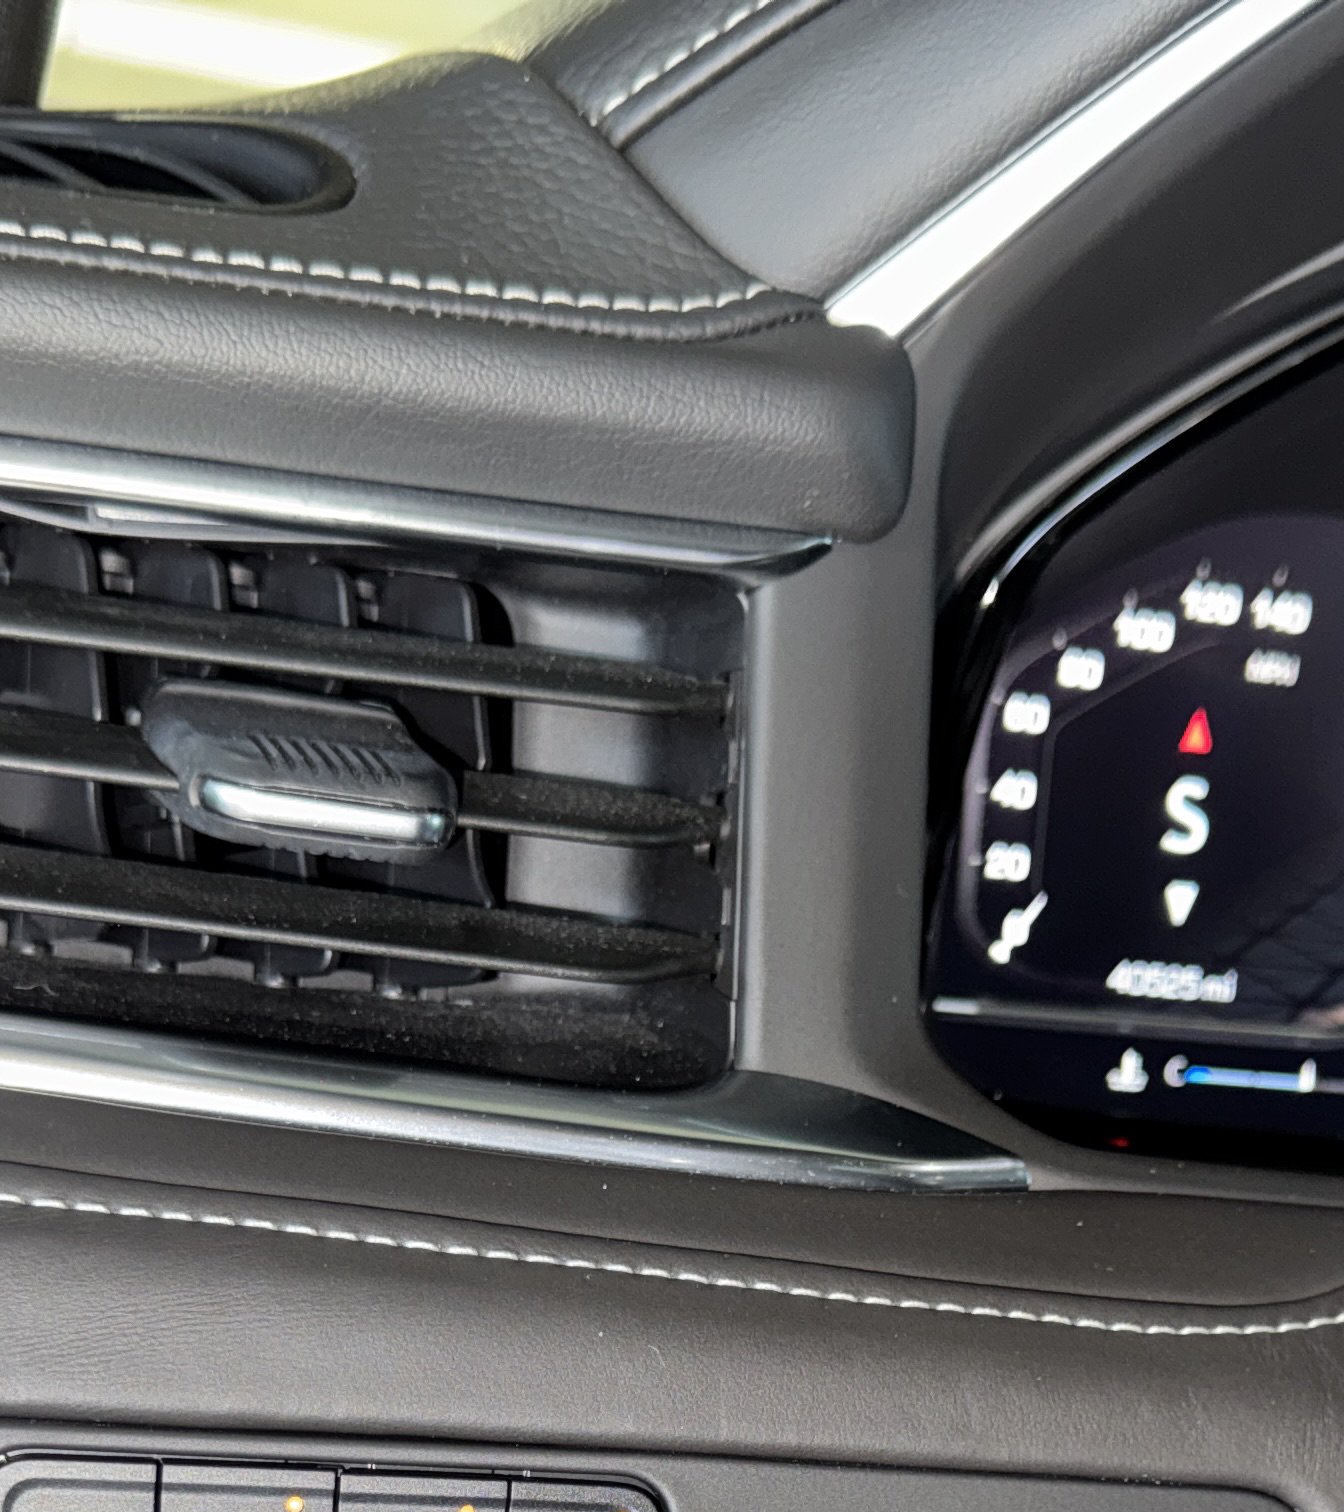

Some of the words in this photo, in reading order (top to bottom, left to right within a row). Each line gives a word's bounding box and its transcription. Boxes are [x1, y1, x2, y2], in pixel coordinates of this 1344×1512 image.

[1113, 607, 1176, 654] 100
[990, 768, 1038, 810] 40
[1159, 774, 1210, 855] S
[983, 841, 1031, 882] 20
